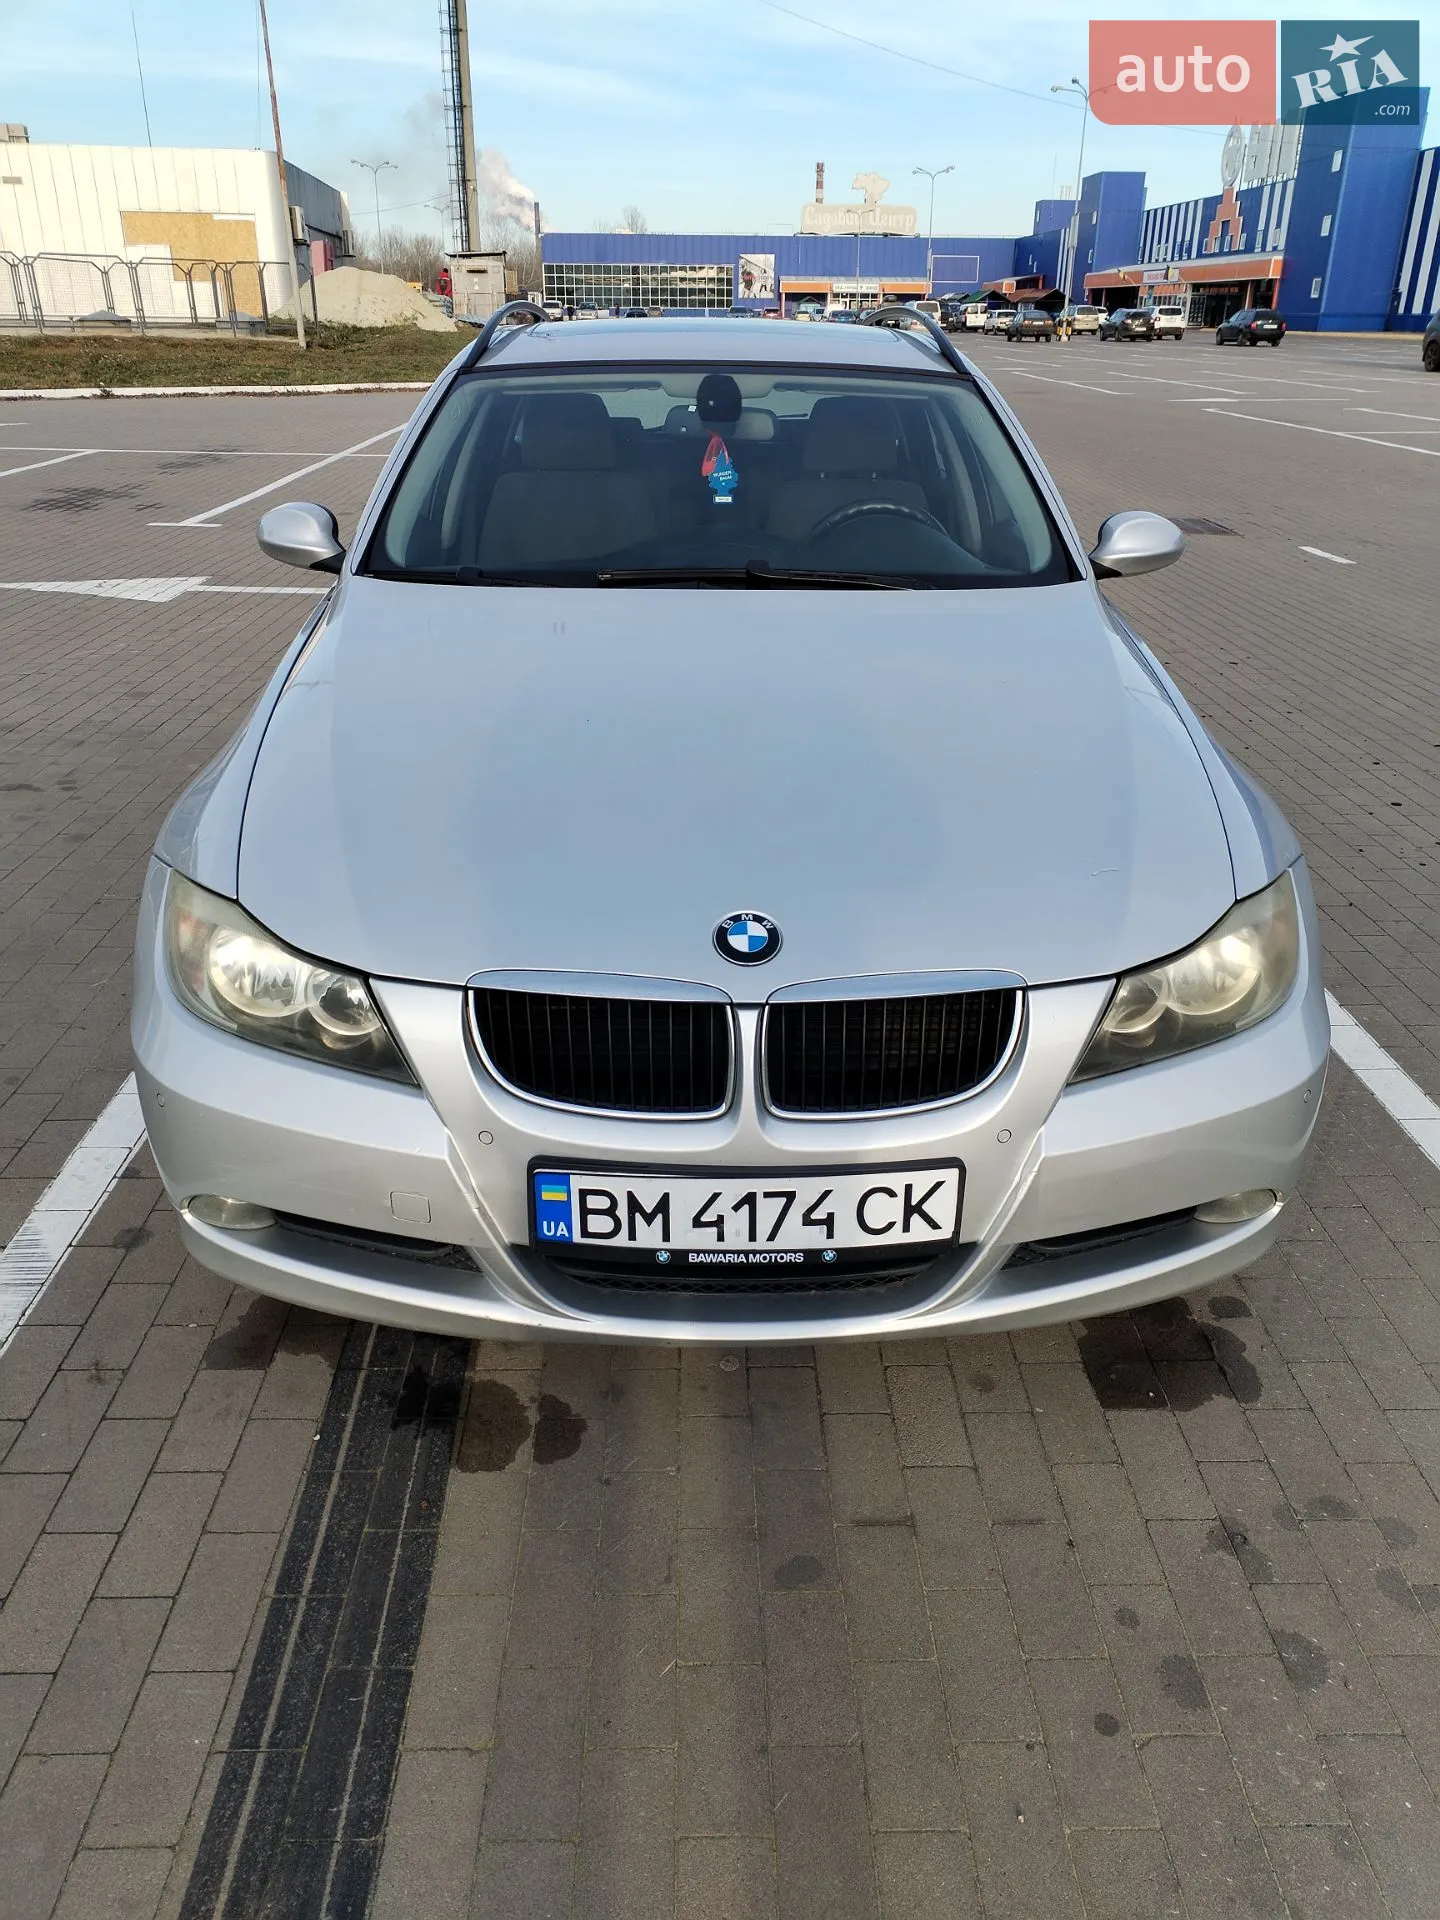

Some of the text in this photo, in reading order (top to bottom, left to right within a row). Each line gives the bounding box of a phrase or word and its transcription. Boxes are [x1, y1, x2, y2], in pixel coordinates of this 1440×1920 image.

[721, 914, 774, 929] BMW
[578, 1180, 946, 1243] BM 4174 CK
[542, 1221, 569, 1238] UA
[688, 1253, 804, 1263] BAWARIA MOTORS
